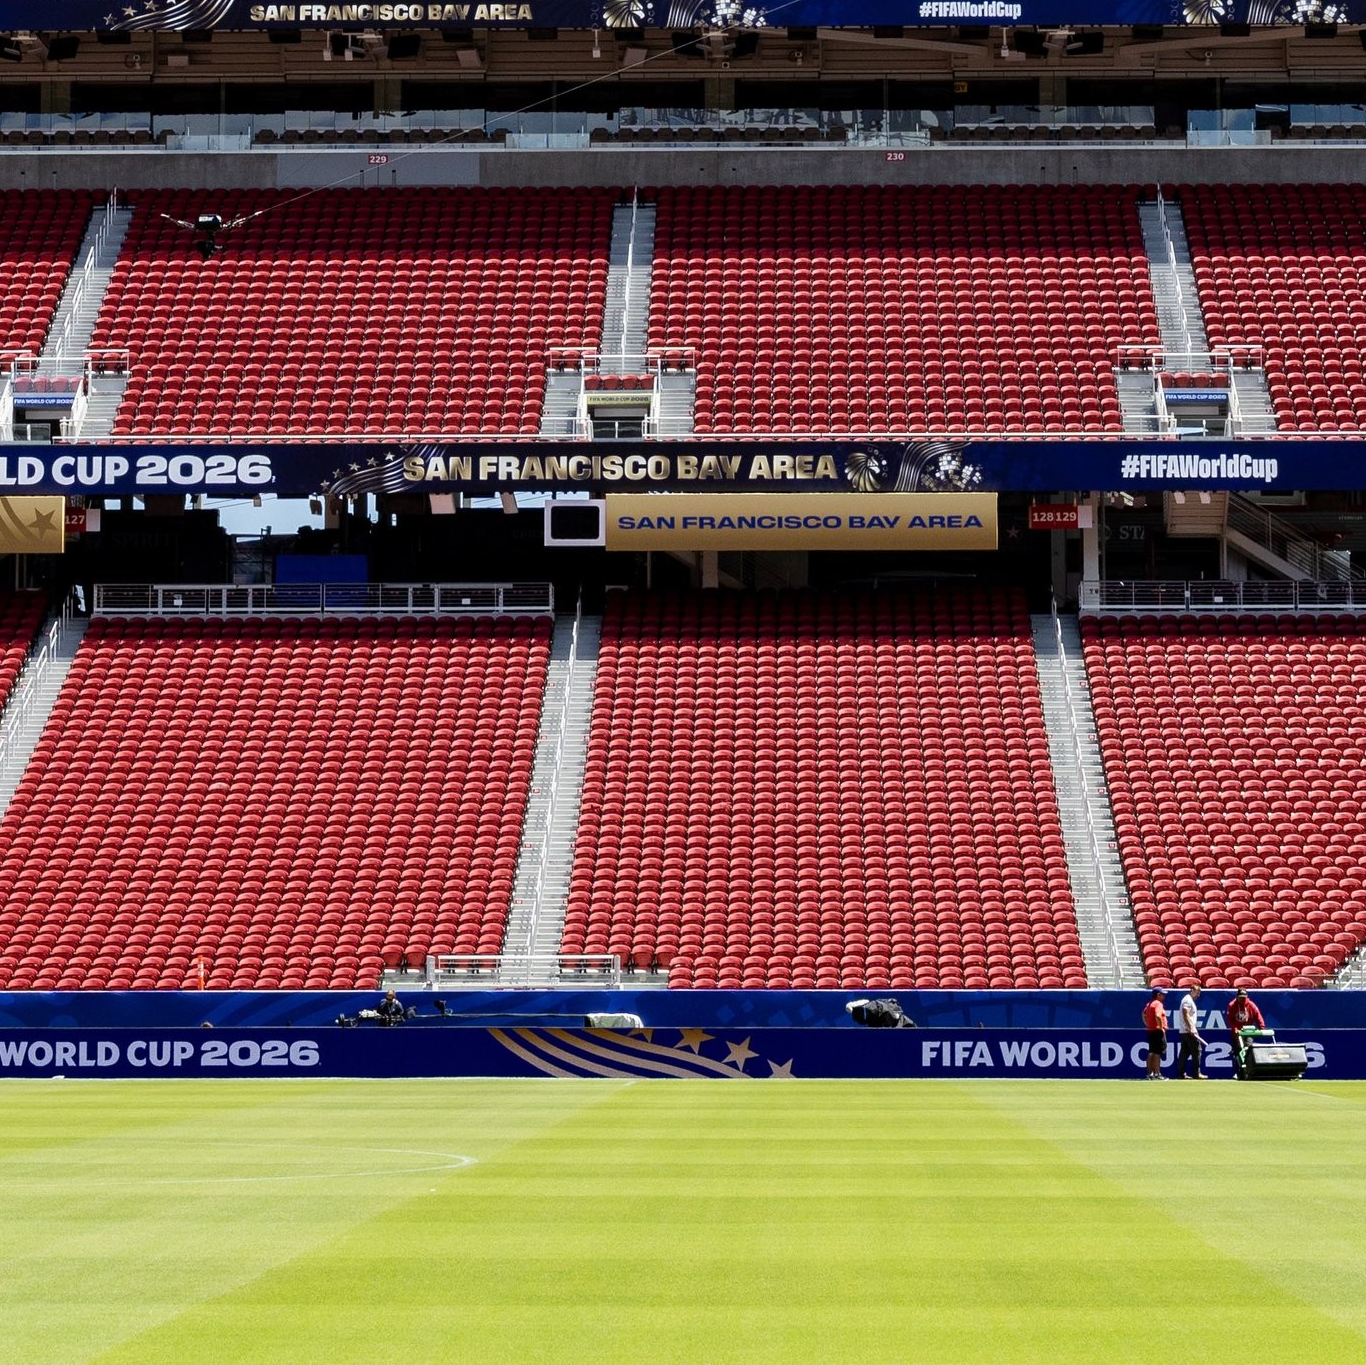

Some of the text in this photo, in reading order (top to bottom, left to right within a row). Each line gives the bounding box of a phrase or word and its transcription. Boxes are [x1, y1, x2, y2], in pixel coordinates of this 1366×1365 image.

[250, 3, 533, 22] SAN FRANCISCO BAY AREA
[919, 0, 1022, 20] #FIFAWorldCup
[369, 155, 386, 164] 229
[886, 152, 904, 161] 230
[51, 456, 130, 486] CUP
[136, 454, 273, 485] 2026
[403, 454, 838, 482] SAN FRANCISCO BAY AREA
[1121, 454, 1278, 483] #FIFAWorldCup
[64, 514, 86, 525] 127
[618, 514, 983, 530] SAN FRANCISCO BAY AREA
[1032, 512, 1053, 522] 128
[1055, 512, 1077, 522] 129
[126, 1040, 194, 1068] CUP
[200, 1040, 320, 1068] 2026
[922, 1041, 1326, 1068] FIFA WORLD CU 26
